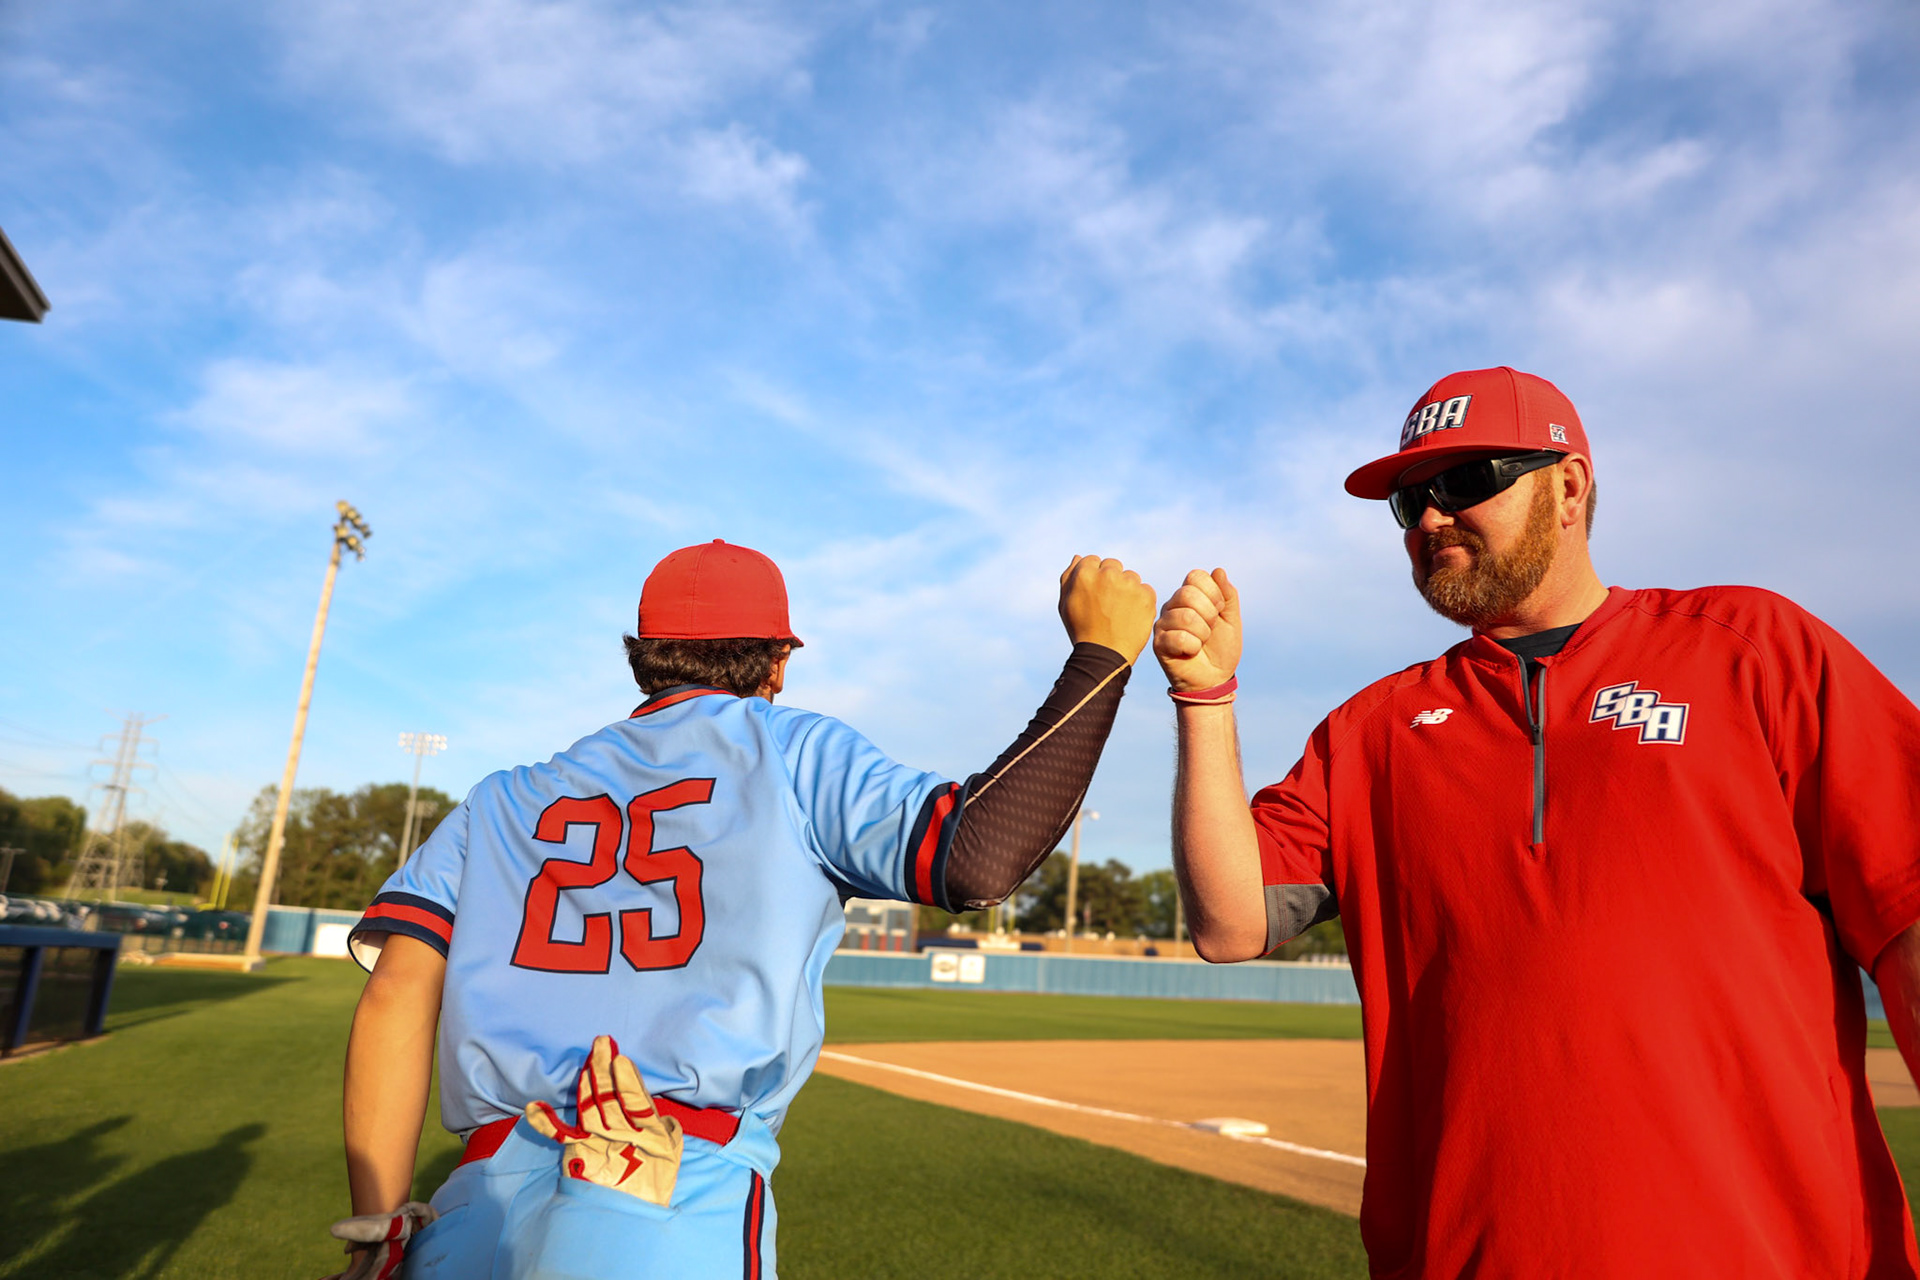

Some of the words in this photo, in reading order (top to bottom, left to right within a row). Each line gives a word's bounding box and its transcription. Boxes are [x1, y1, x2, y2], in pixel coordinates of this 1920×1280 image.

[1400, 395, 1472, 449] SBA
[1589, 681, 1689, 745] SBA
[510, 778, 717, 974] 25
